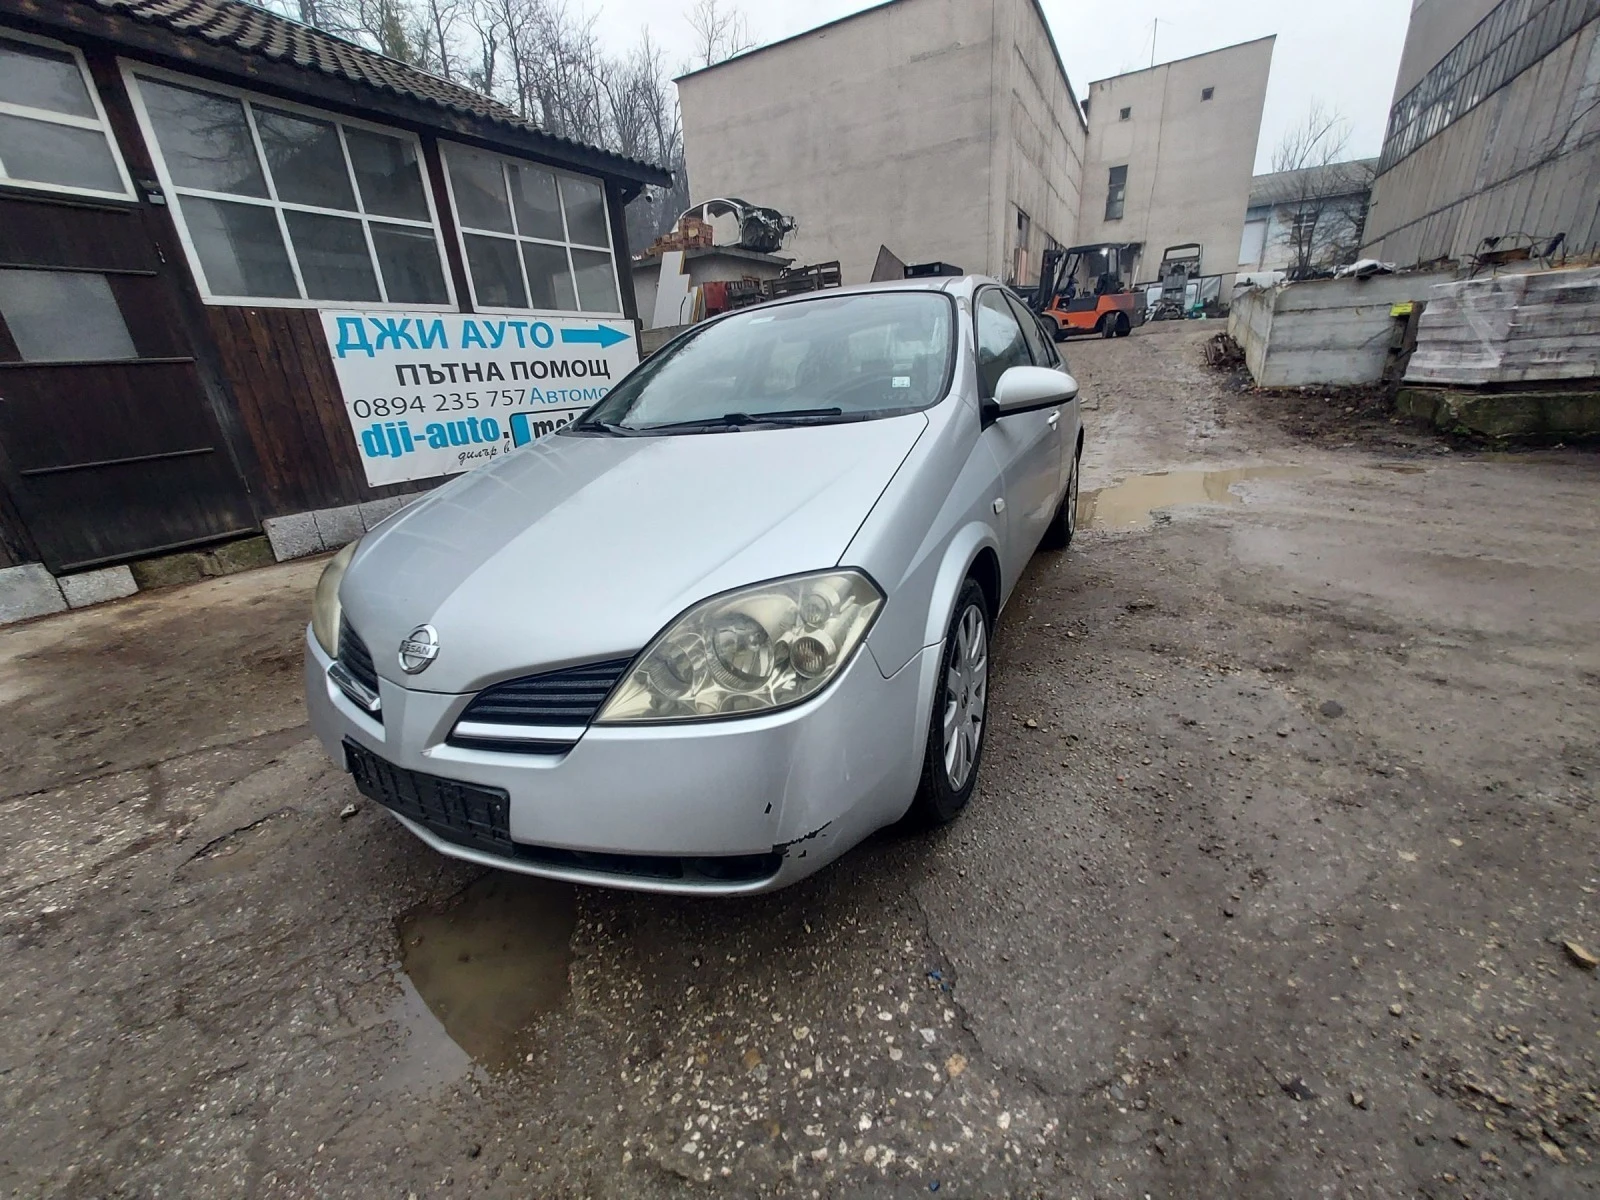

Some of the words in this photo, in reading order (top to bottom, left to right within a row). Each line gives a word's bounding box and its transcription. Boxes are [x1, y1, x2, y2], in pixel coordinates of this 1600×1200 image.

[335, 317, 449, 358] ДЖИ
[461, 319, 555, 350] АУТО
[395, 361, 505, 387] ПЪТНА
[510, 358, 611, 381] ПОМОЩ
[353, 393, 427, 419] 0894
[433, 391, 480, 412] 235
[486, 388, 526, 407] 757
